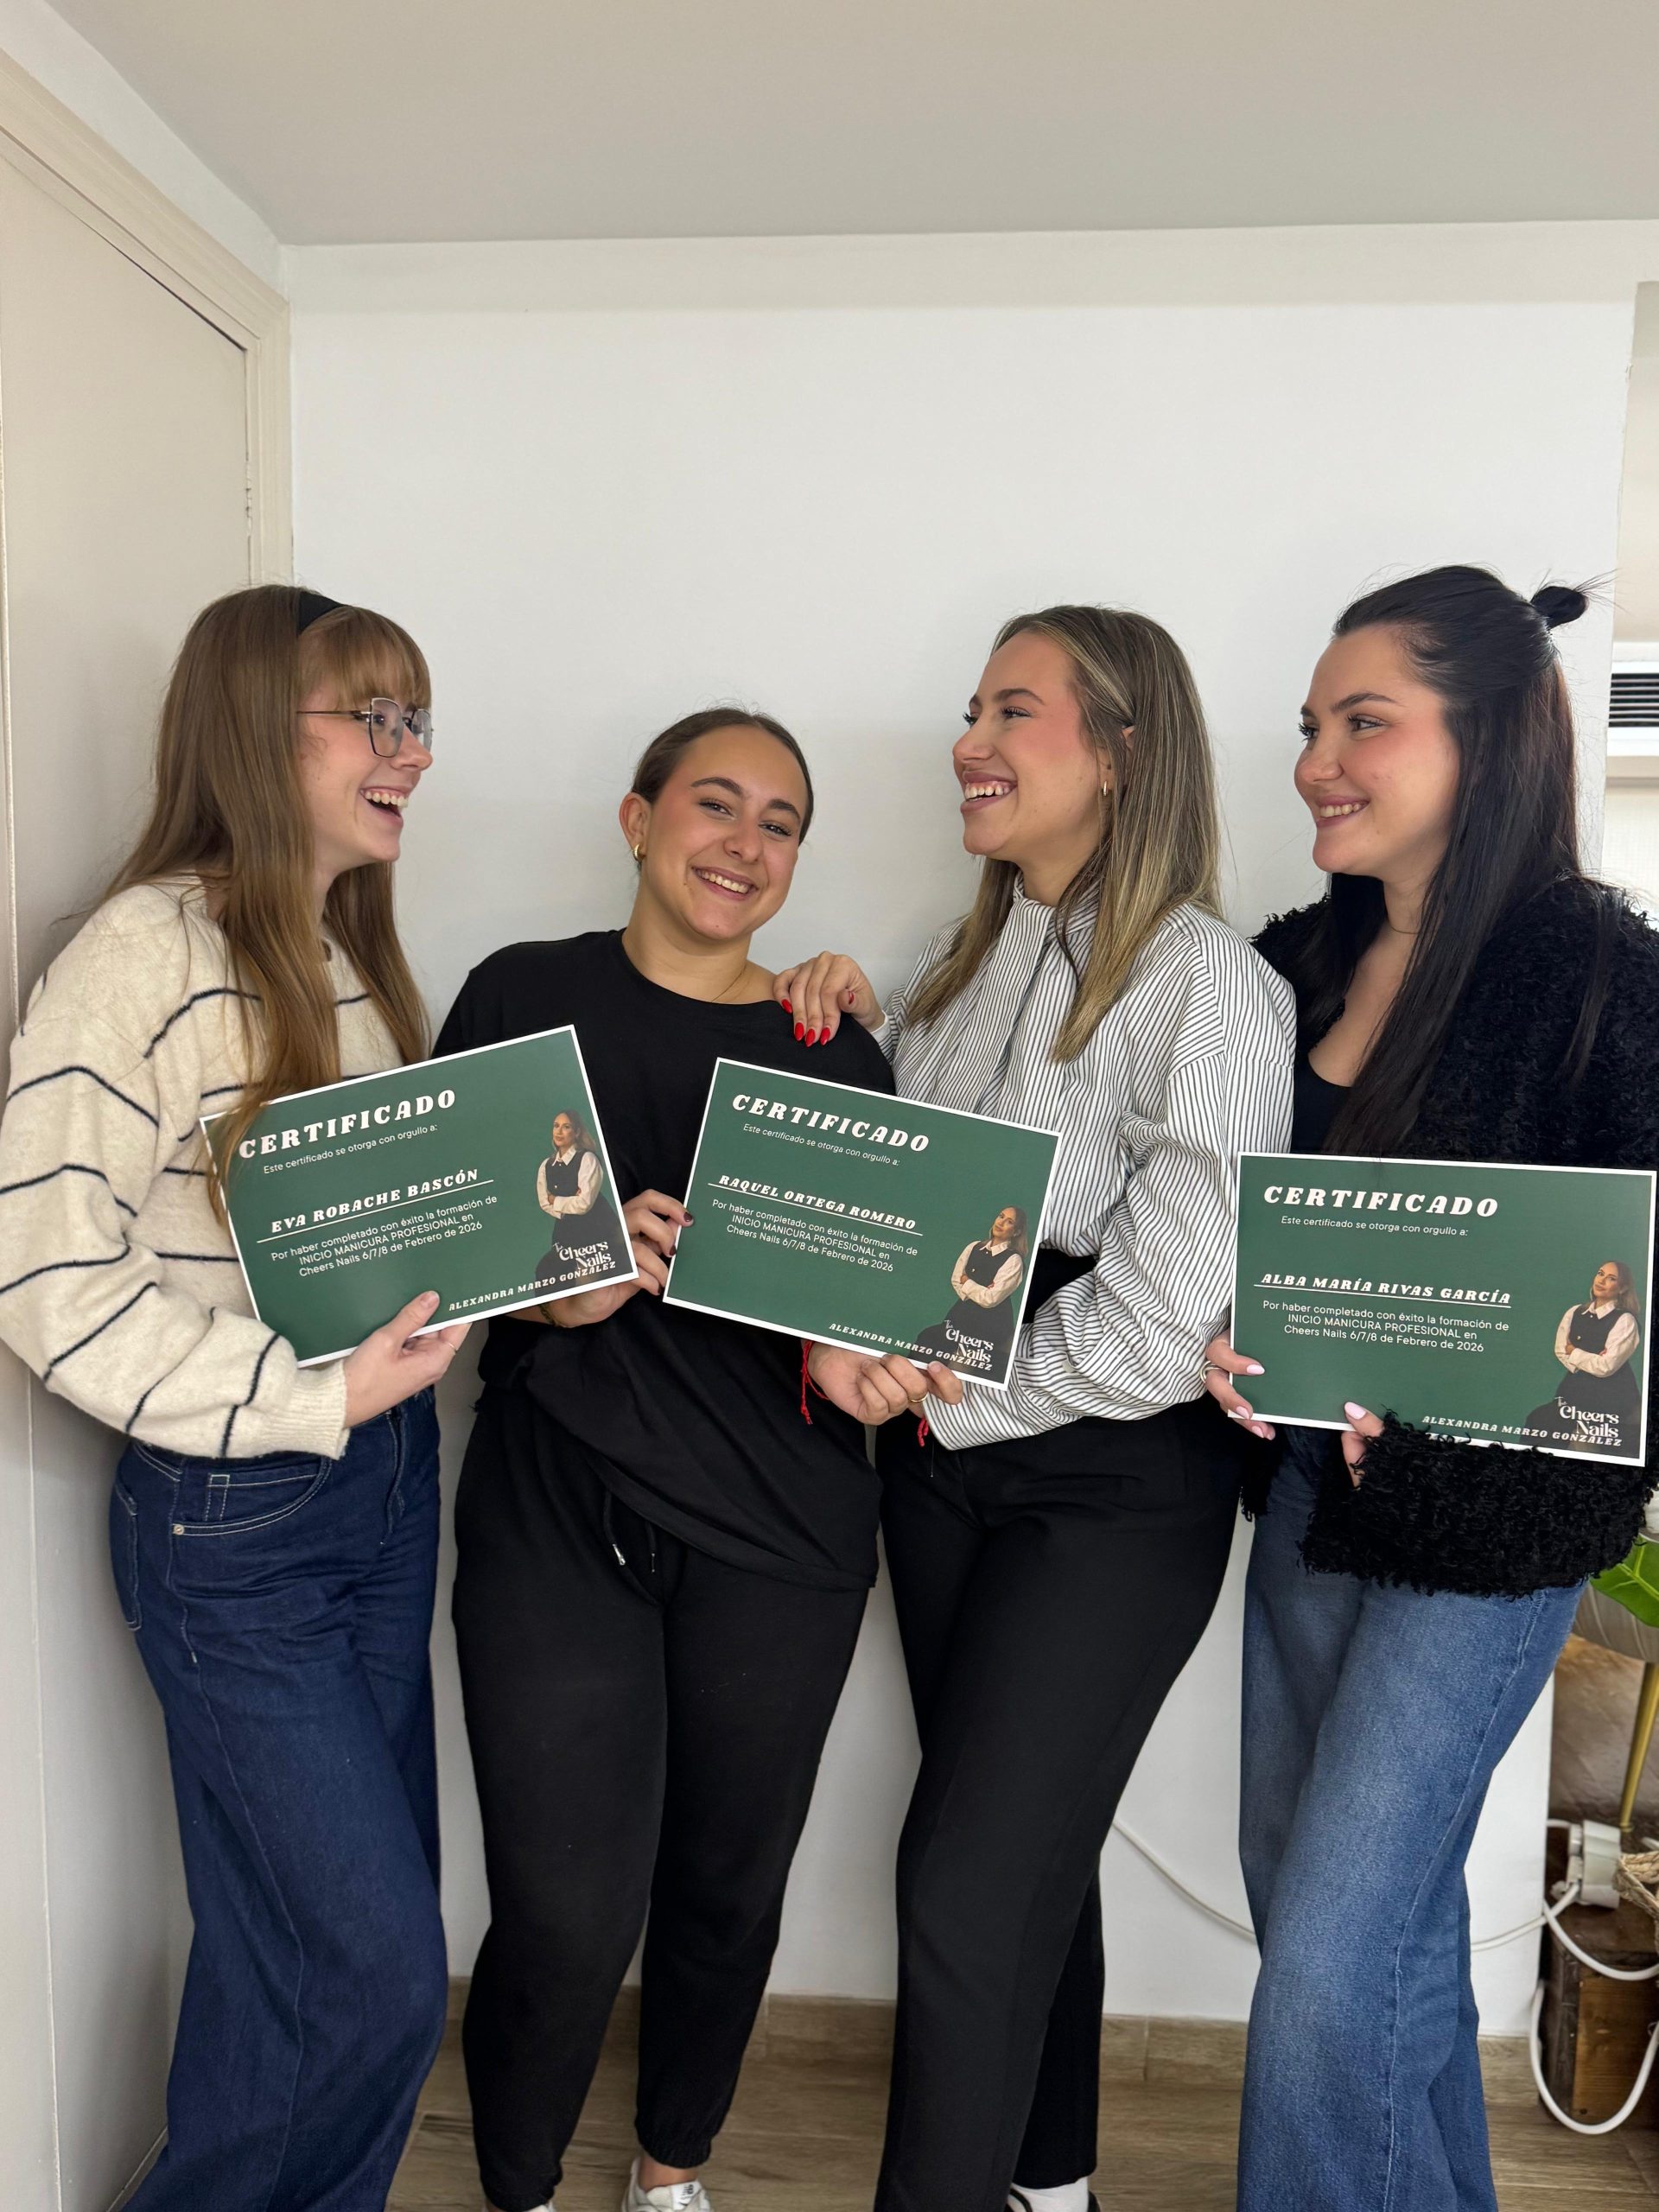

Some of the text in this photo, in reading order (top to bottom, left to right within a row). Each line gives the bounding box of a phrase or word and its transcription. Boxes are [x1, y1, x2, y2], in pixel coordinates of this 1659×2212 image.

[238, 1089, 455, 1159] CERTIFICADO
[732, 1094, 930, 1152] CERTIFICADO
[263, 1164, 283, 1174] Este
[285, 1150, 334, 1168] certificado
[335, 1147, 346, 1156] se
[347, 1140, 377, 1153] otorga
[378, 1135, 396, 1145] con
[397, 1126, 429, 1140] orgullo
[743, 1123, 761, 1134] Este
[762, 1128, 805, 1144] certificado
[817, 1141, 844, 1154] otorga
[845, 1148, 861, 1157] con
[861, 1152, 891, 1164] orgullo
[271, 1168, 478, 1233] EVA ROBACHE BASCÓN
[718, 1174, 916, 1230] RAQUEL ORTEGA ROMERO
[1263, 1185, 1498, 1217] CERTIFICADO
[270, 1195, 498, 1262] Por haber completado con éxito la formación de
[299, 1213, 474, 1265] INICIO MANICURA PROFESIONAL en
[712, 1198, 918, 1256] Por haber completado con éxito la formación de
[732, 1214, 890, 1261] INICIO MANICURA PROFESIONAL en
[1281, 1215, 1301, 1225] Este
[1303, 1218, 1354, 1228] certificado
[1369, 1223, 1400, 1233] otorga
[1422, 1226, 1457, 1236] orgullo
[299, 1221, 483, 1277] Cheers Nails 6/7/8 de Febrero de 2026
[559, 1241, 609, 1262] Cheers
[575, 1251, 612, 1270] Nails
[727, 1224, 893, 1272] Cheers Nails 6/7/8 de Febrero de 2026
[448, 1287, 514, 1312] ALEXANDRA
[518, 1276, 556, 1294] MARZO
[1261, 1273, 1510, 1304] ALBA MARÍA RIVAS GARCÍA
[1262, 1300, 1510, 1332] Por haber completado con éxito la formación de
[1288, 1313, 1478, 1340] INICIO MANICURA PROFESIONAL en
[829, 1323, 893, 1344] ALEXANDRA
[893, 1339, 933, 1355] MARZO
[945, 1328, 995, 1351] Cheers
[956, 1343, 992, 1363] Nails
[1284, 1325, 1484, 1352] Cheers Nails 6/7/8 de Febrero de 2026
[1421, 1415, 1498, 1432] ALEXANDRA
[1501, 1425, 1548, 1438] MARZO
[1559, 1405, 1619, 1425] Cheers
[1576, 1420, 1619, 1439] Nails
